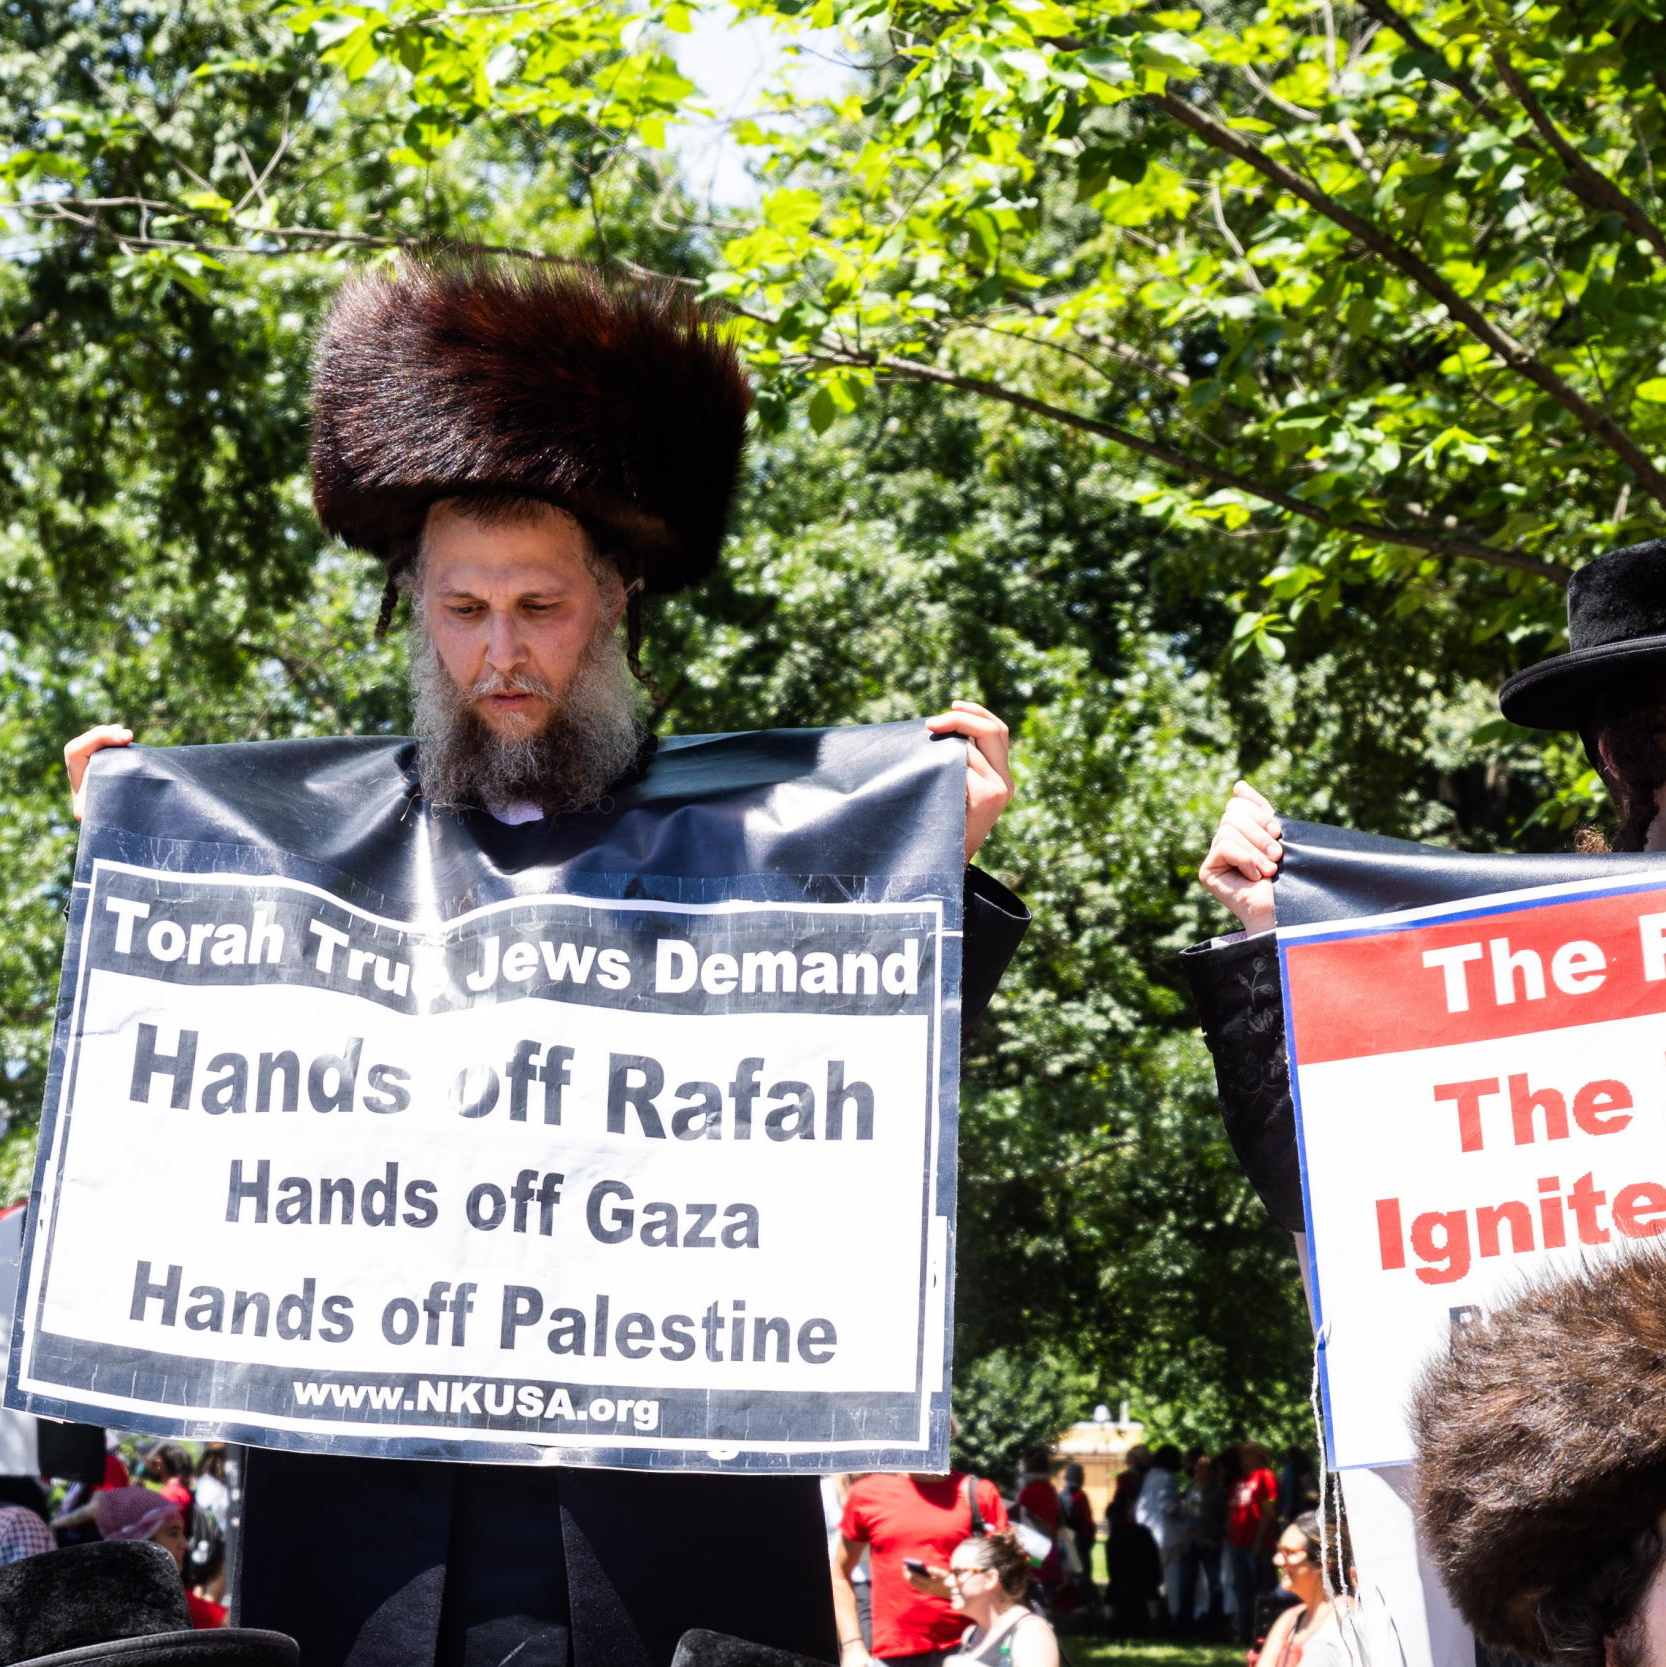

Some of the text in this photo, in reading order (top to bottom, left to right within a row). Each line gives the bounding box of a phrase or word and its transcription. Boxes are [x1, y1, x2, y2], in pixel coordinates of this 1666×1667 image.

[106, 897, 284, 967] Torah
[467, 937, 631, 994] Jews
[656, 938, 919, 996] Demand
[1421, 938, 1607, 1014] The
[128, 1022, 876, 1142] Hands off Rafah
[1433, 1071, 1635, 1153] The
[224, 1158, 761, 1250] Hands off Gaza
[129, 1260, 839, 1365] Hands off Palestine
[293, 1378, 660, 1431] www.NKUSA.org
